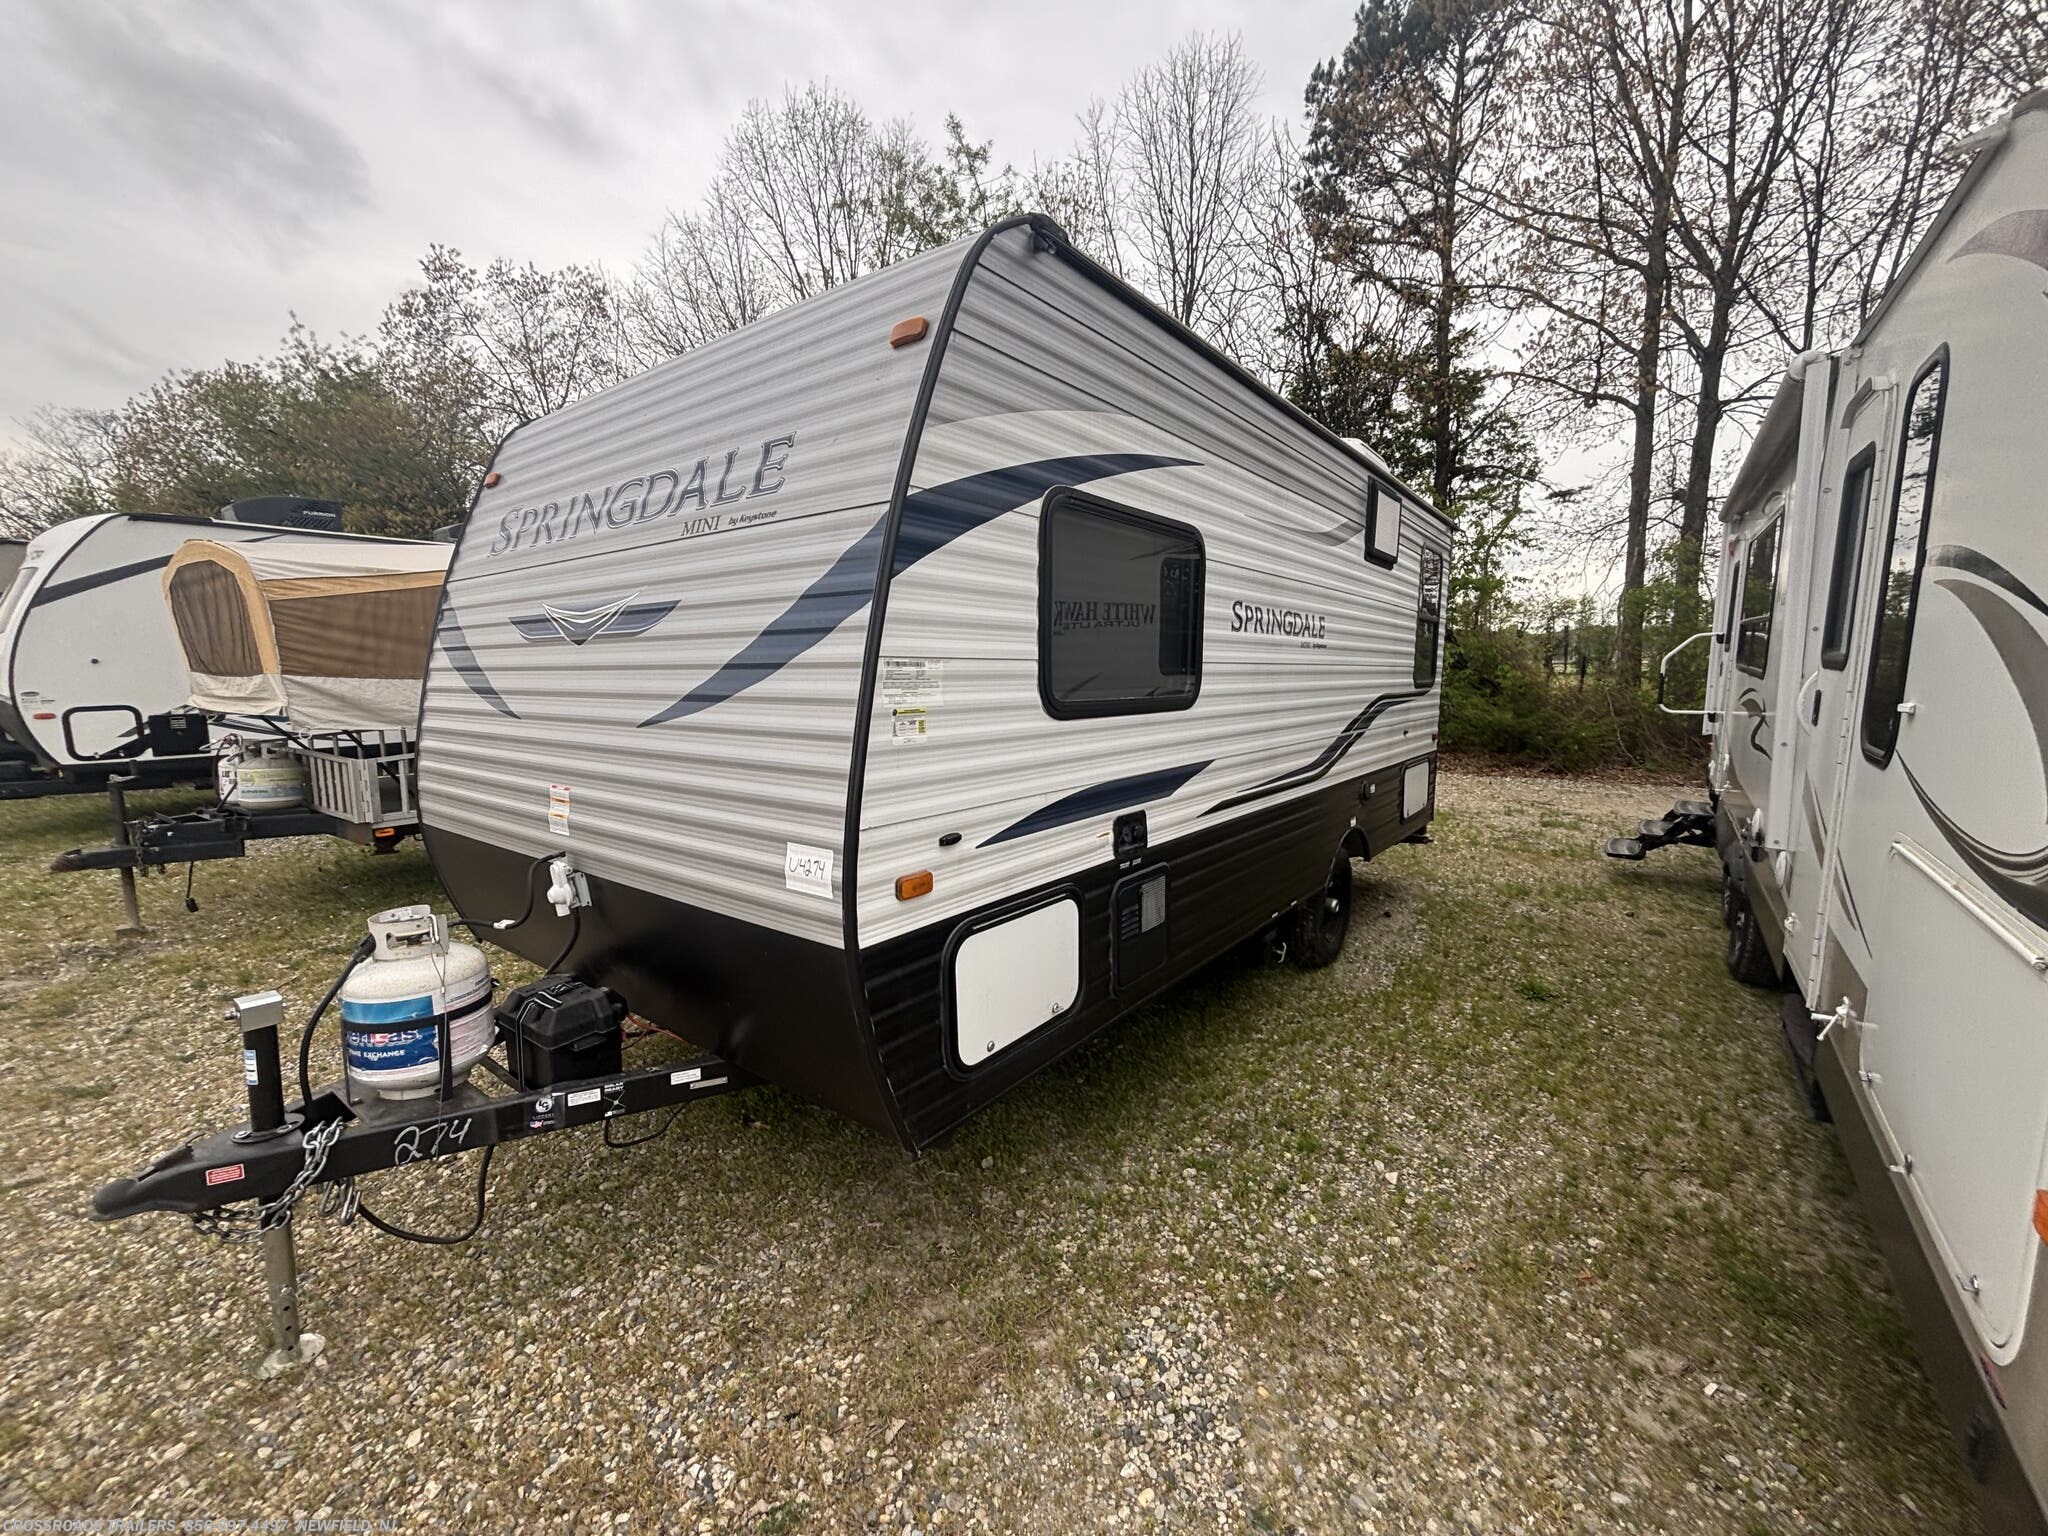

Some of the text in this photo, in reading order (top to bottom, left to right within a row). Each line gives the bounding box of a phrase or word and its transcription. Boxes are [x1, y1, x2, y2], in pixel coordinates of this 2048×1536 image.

[487, 431, 797, 557] SPRINGDALE
[681, 510, 777, 536] MINI by Keystone
[1231, 600, 1325, 639] SPRINGDALE
[363, 1049, 406, 1059] EXCHANGE
[394, 1118, 472, 1165] 274
